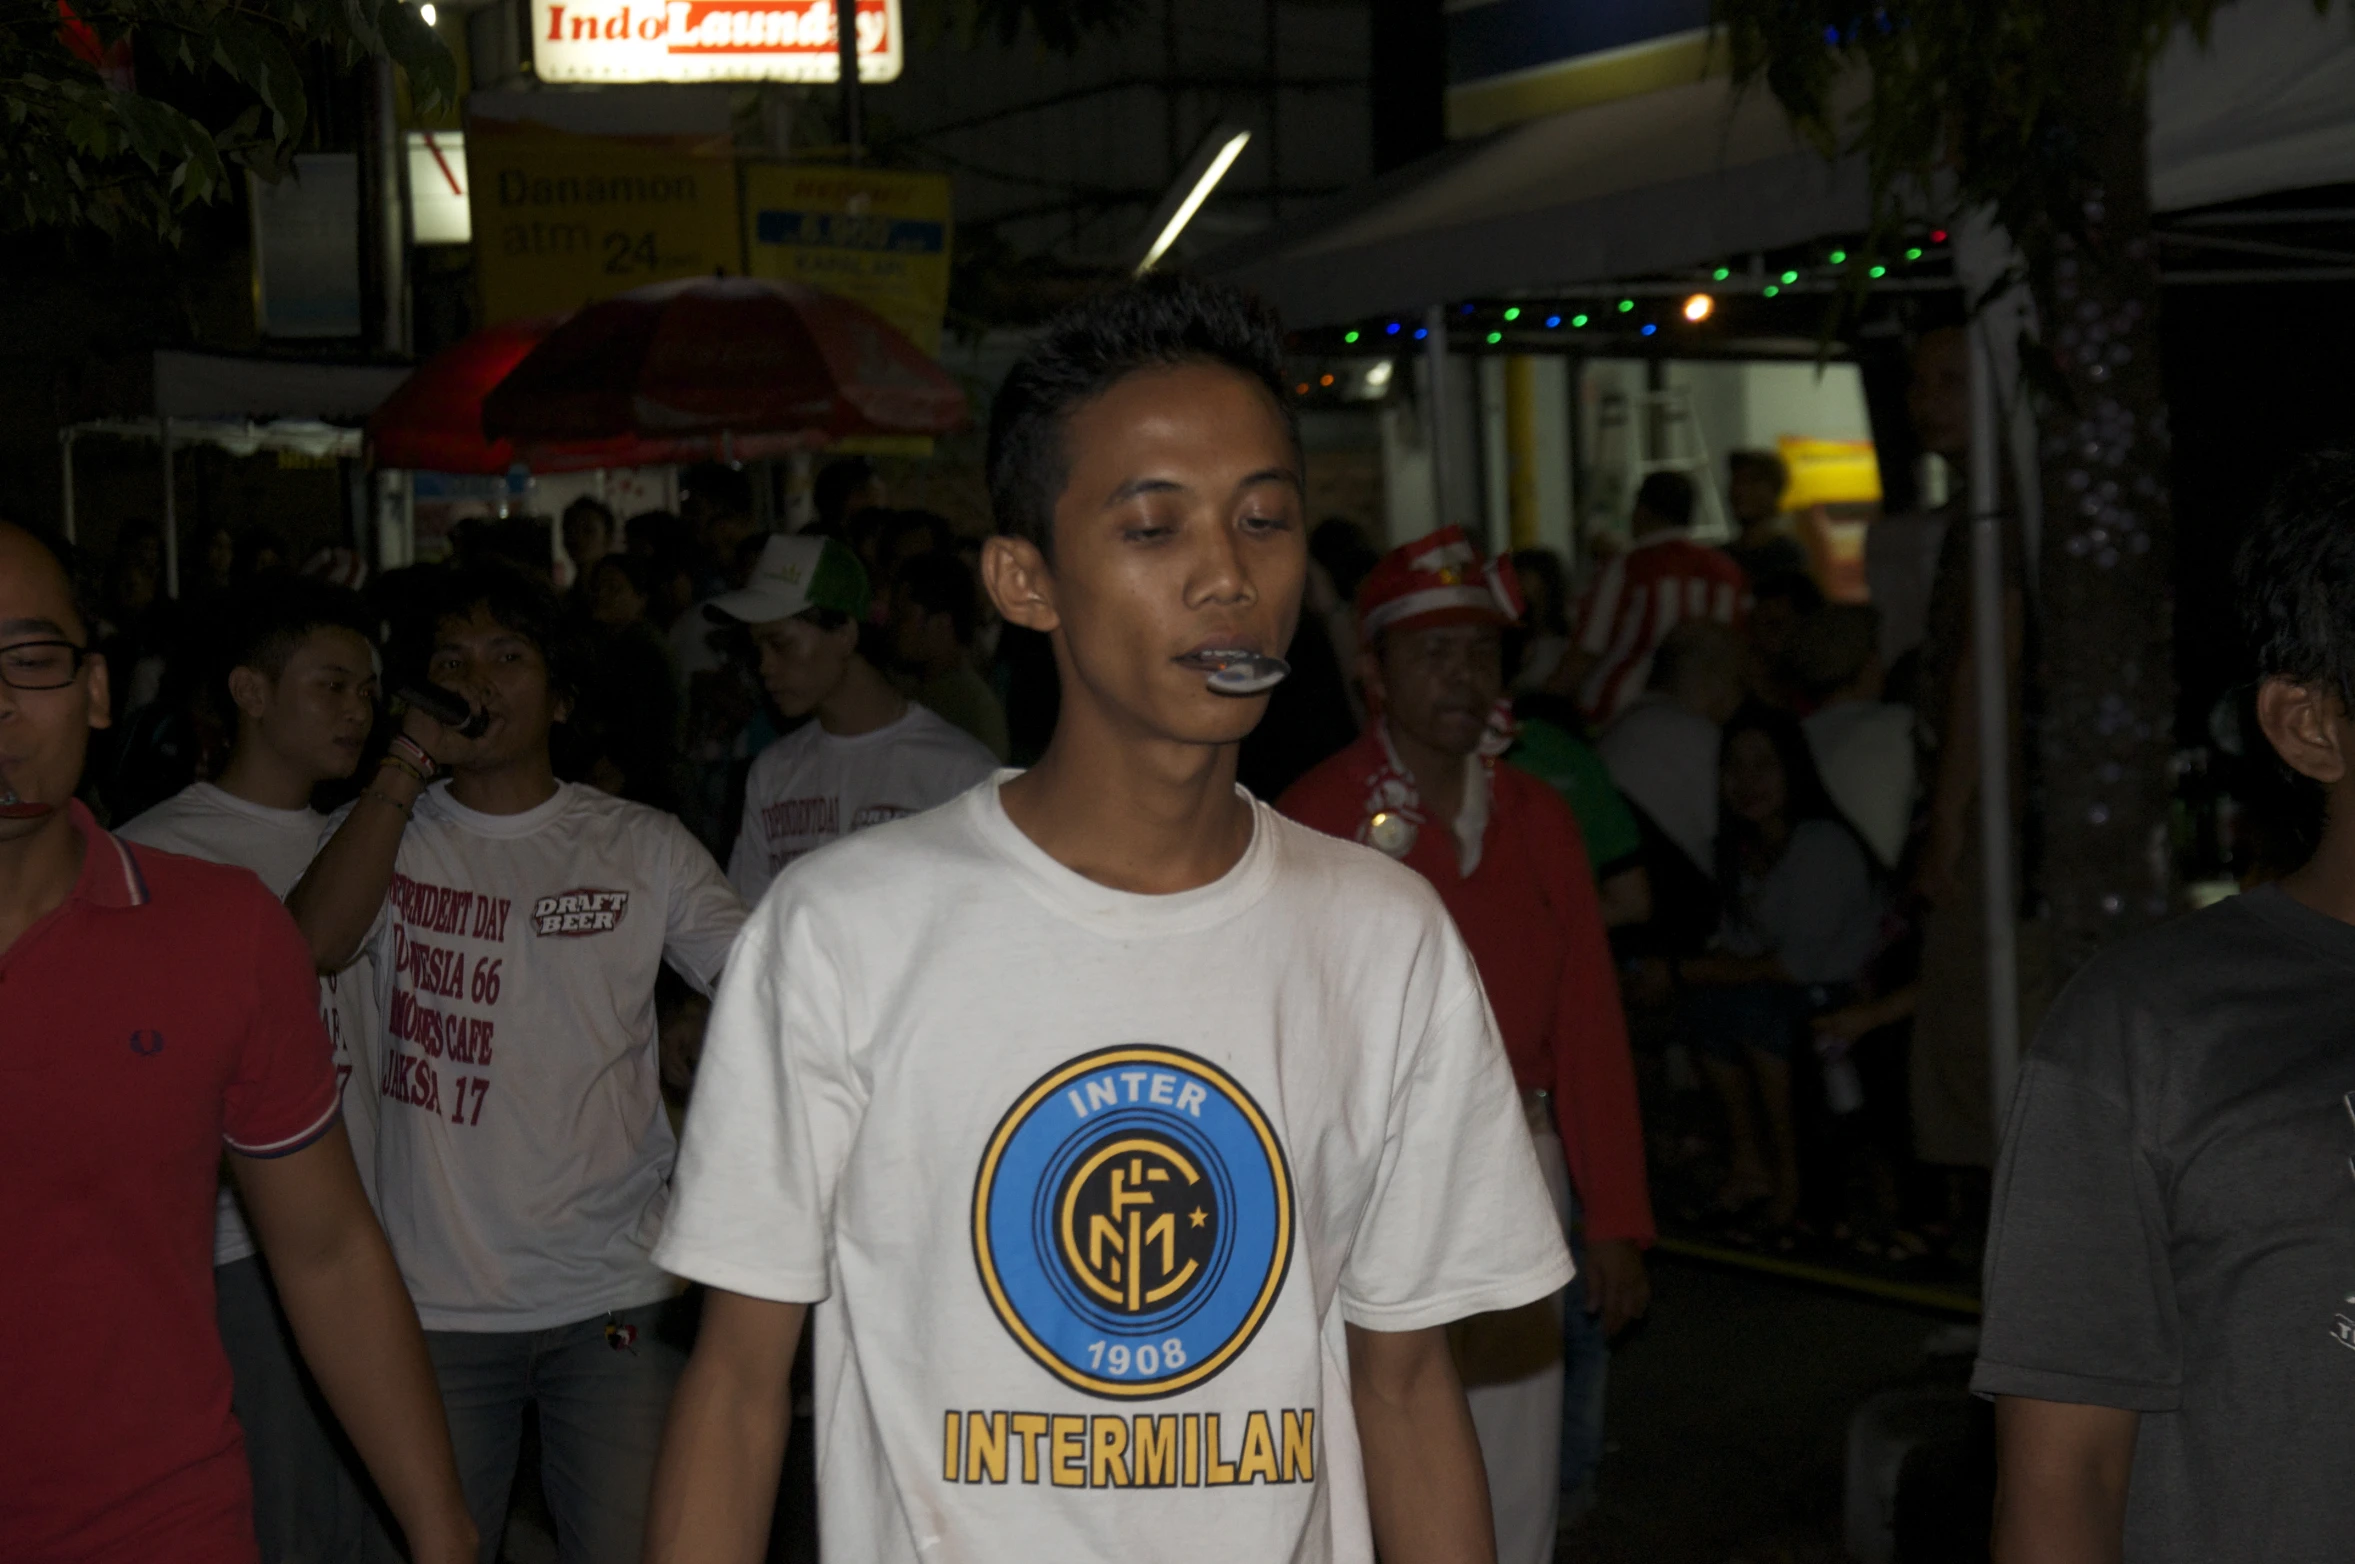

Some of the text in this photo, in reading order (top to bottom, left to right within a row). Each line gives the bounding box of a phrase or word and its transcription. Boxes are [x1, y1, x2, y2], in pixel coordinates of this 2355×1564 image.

[547, 1, 888, 52] IndoLaundy
[498, 167, 698, 207] Danamon
[502, 221, 591, 255] atm
[602, 229, 660, 275] 24
[472, 896, 511, 943] DAY
[535, 892, 628, 918] DRAFT
[540, 911, 614, 935] BEER
[472, 957, 503, 1005] 66
[446, 1013, 494, 1065] CAFE
[382, 1050, 490, 1126] JAKSA 17
[1067, 1071, 1208, 1119] INTER
[1087, 1337, 1188, 1376] 1908
[942, 1408, 1315, 1488] INTERMILAN
